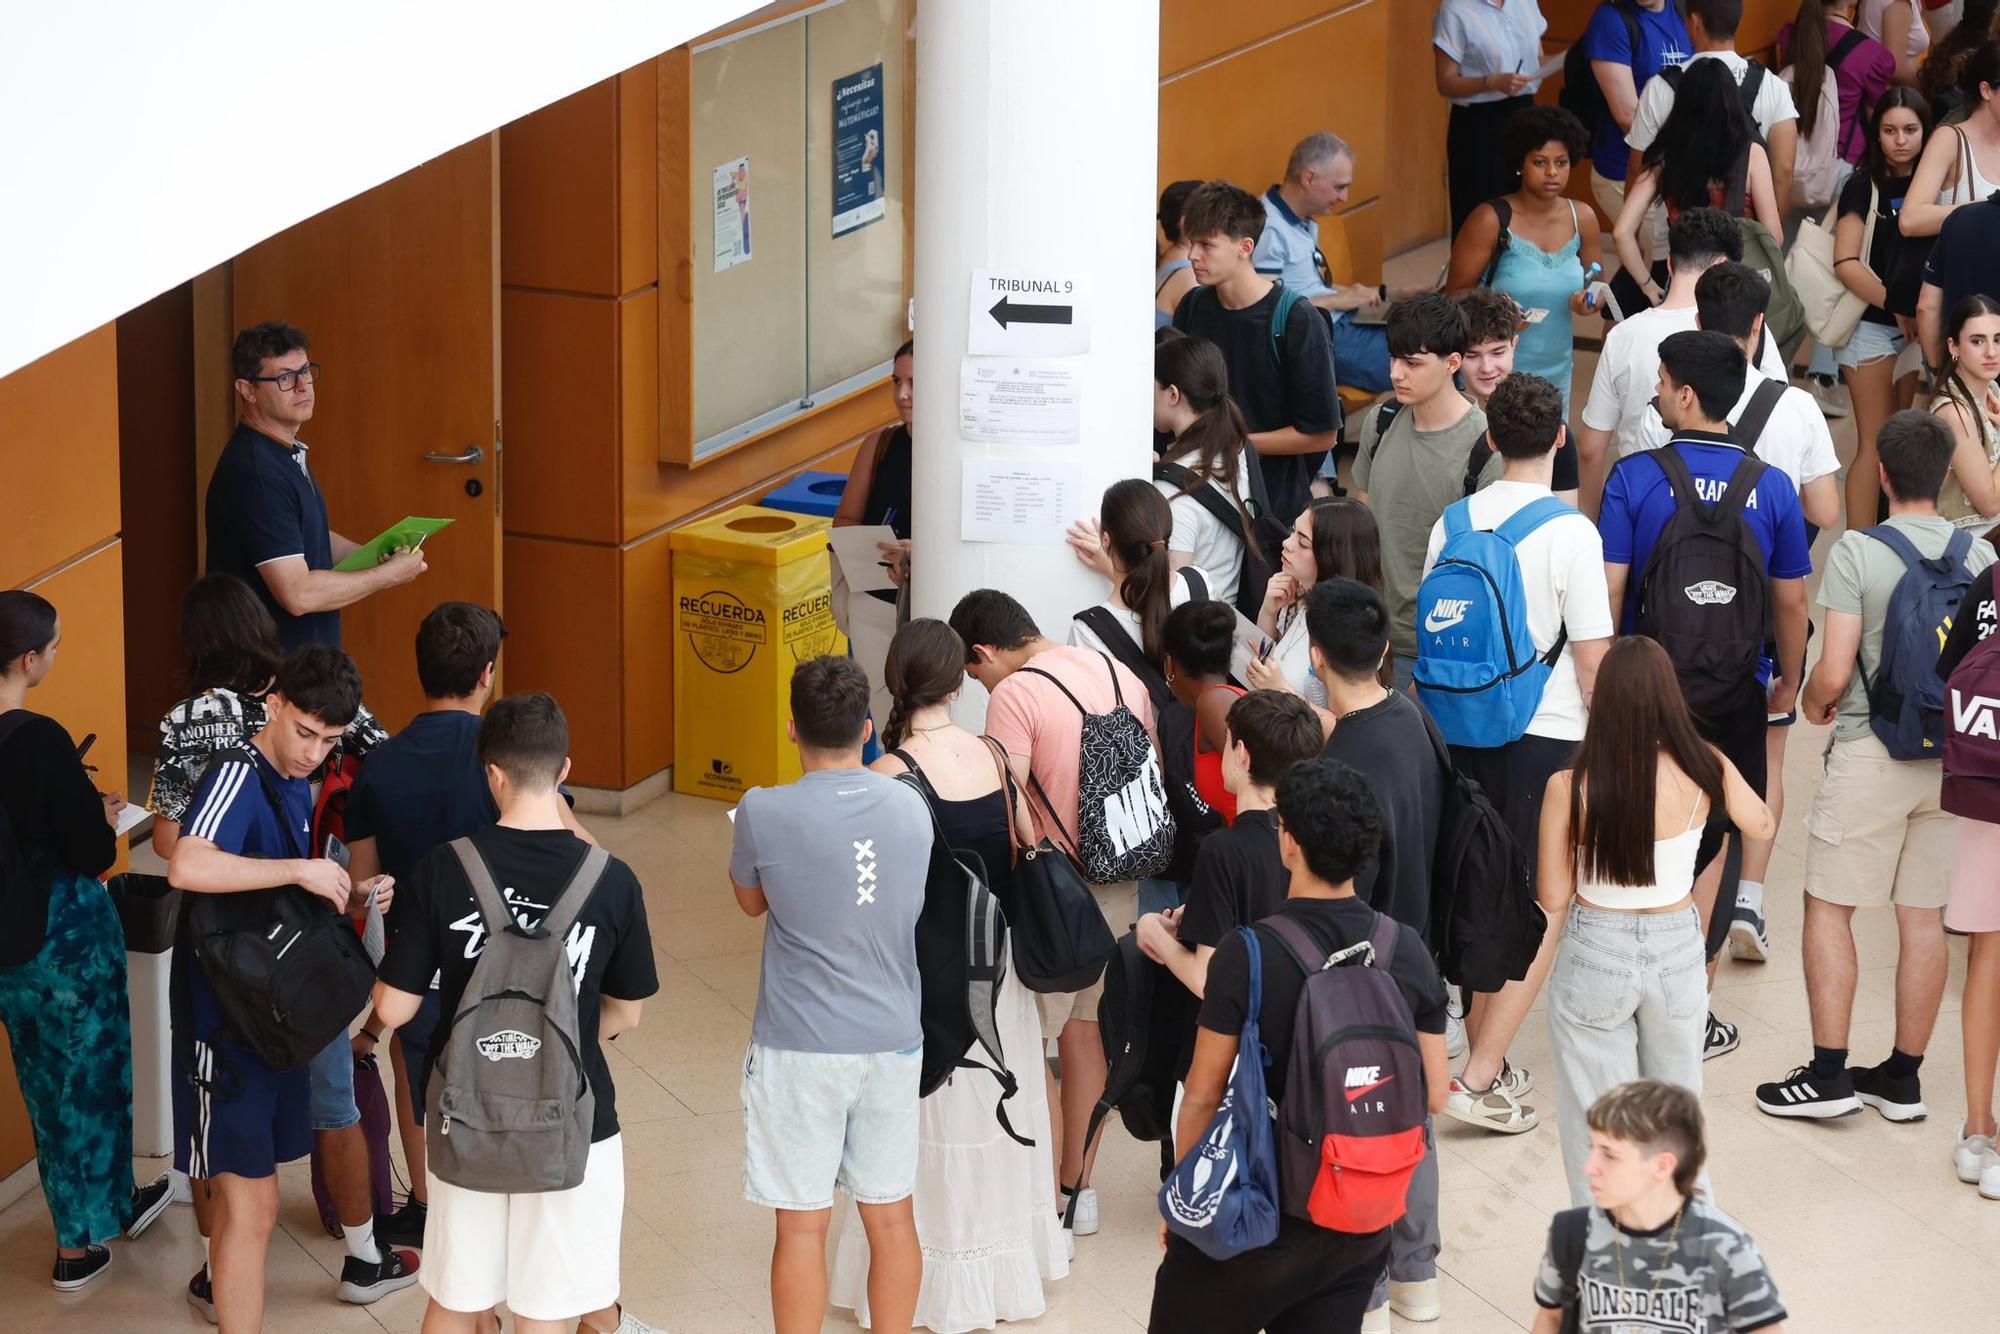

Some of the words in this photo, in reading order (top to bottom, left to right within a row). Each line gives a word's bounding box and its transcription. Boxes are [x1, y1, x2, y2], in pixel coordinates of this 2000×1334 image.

[988, 277, 1061, 294] TRIBUNAL
[1064, 280, 1073, 294] 9
[679, 596, 766, 625] RECUERDA
[783, 593, 832, 623] RECUER
[1432, 598, 1469, 619] NIKE
[1435, 635, 1469, 648] AIR
[1951, 688, 2000, 741] VA
[180, 721, 240, 741] ANOTHER
[1104, 743, 1168, 857] NIK
[500, 1042, 515, 1053] THE
[1345, 1066, 1381, 1087] NIKE
[1350, 1101, 1385, 1114] AIR
